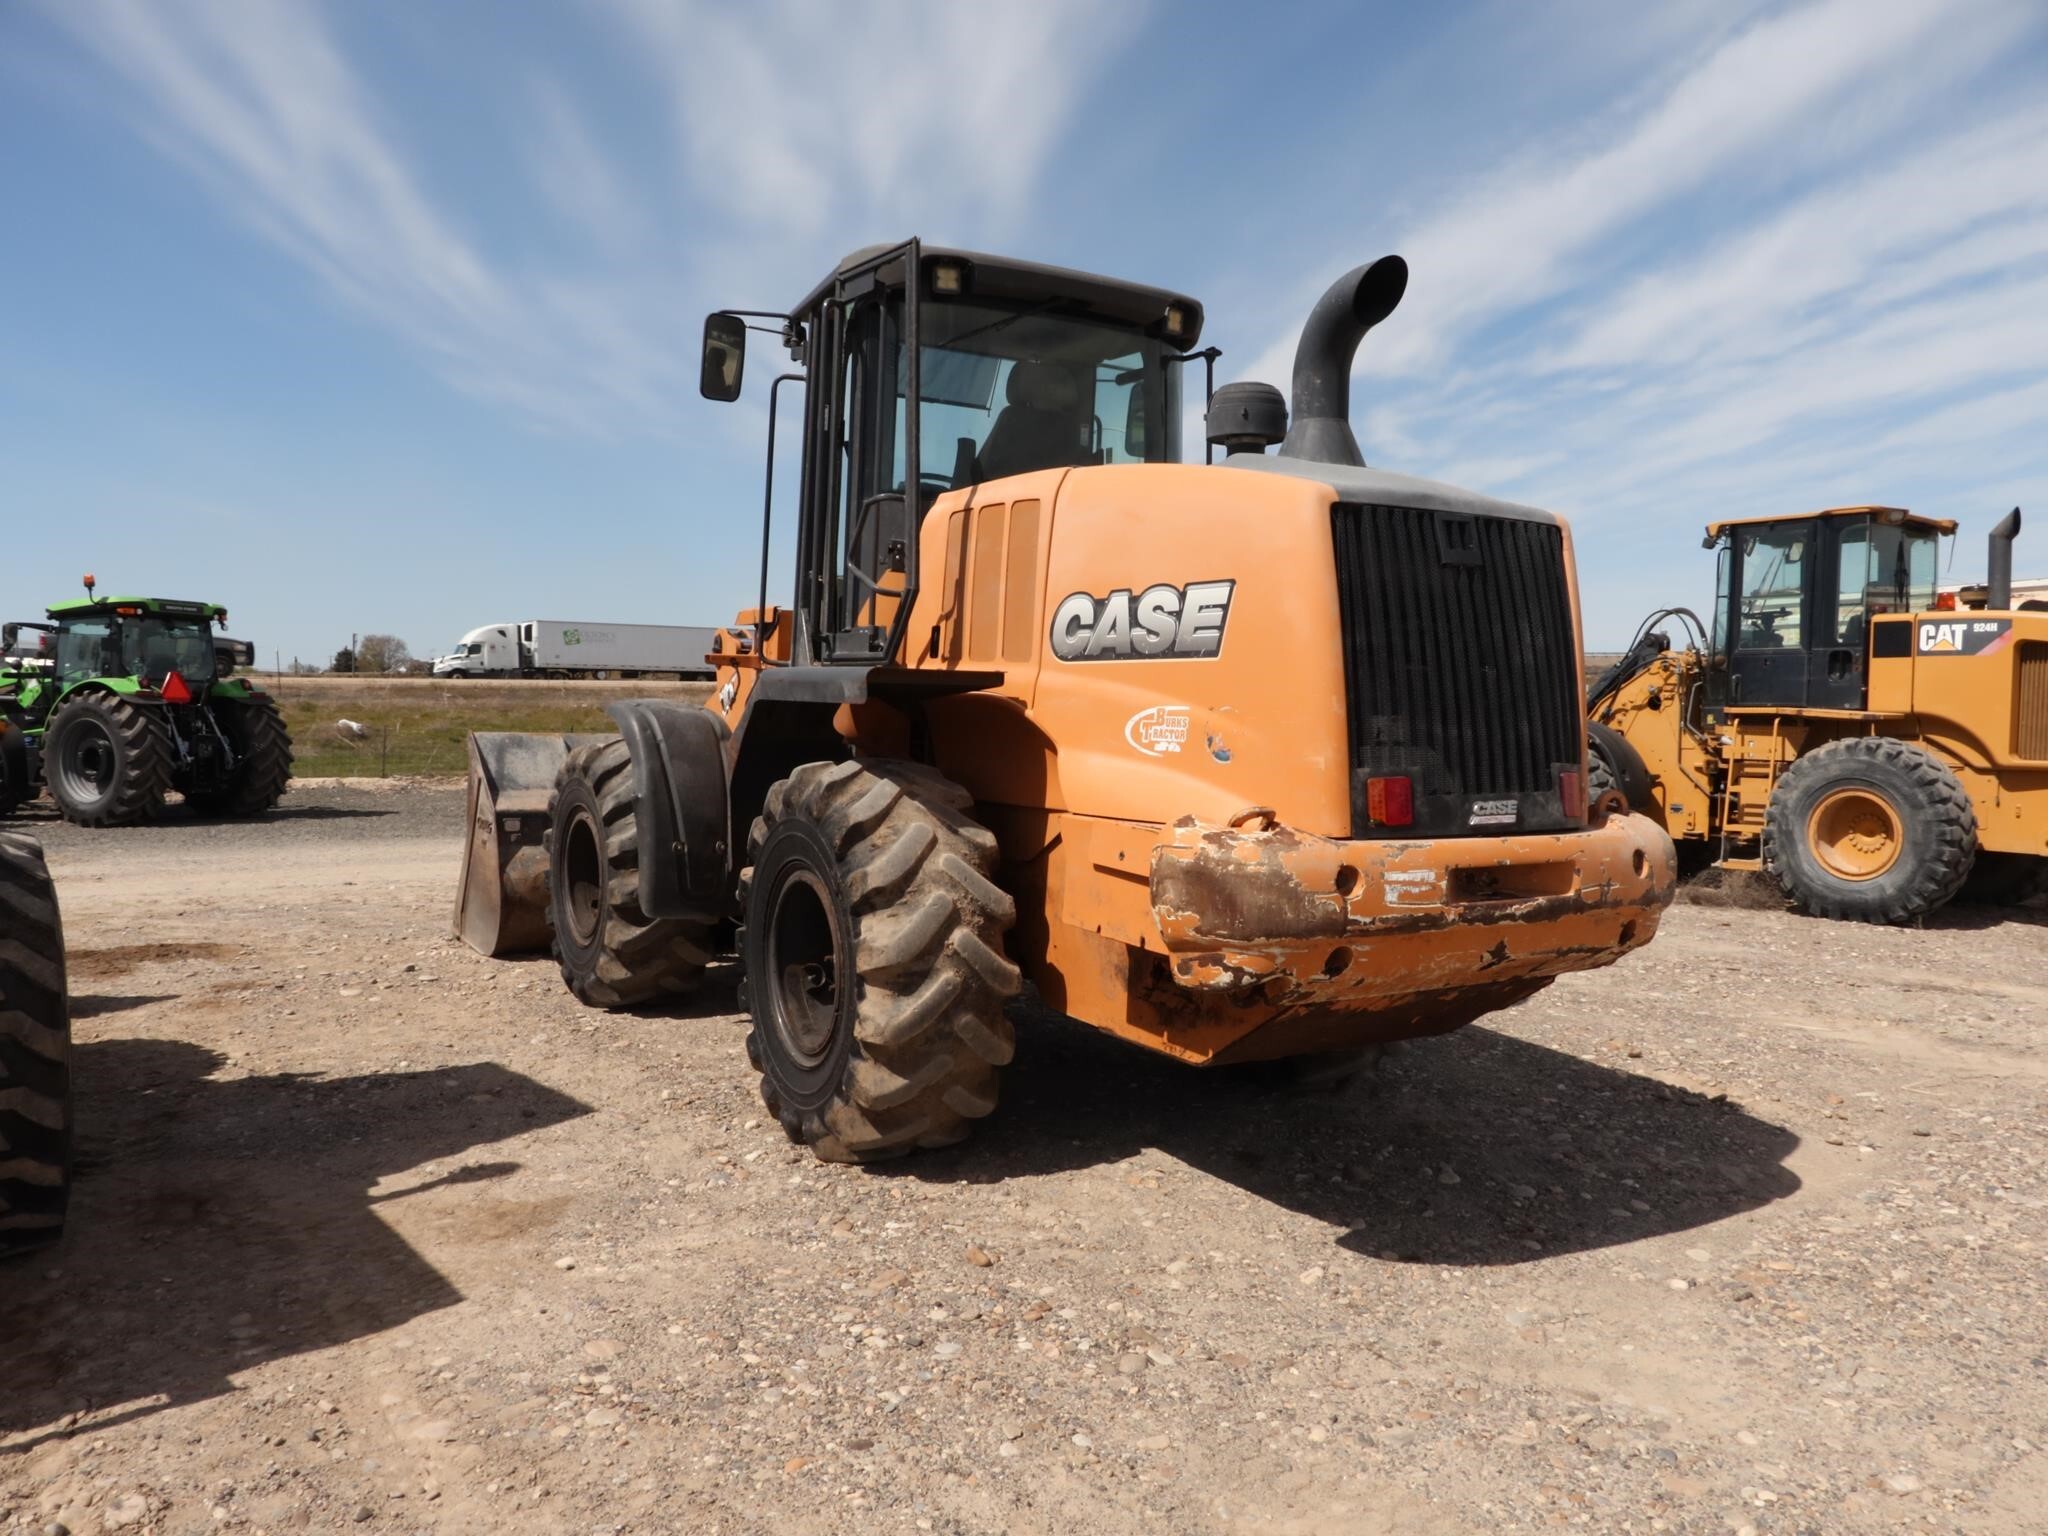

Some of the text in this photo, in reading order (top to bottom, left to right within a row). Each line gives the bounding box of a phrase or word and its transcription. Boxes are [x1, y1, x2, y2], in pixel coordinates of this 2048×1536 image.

[1051, 581, 1234, 660] CASE
[1919, 622, 1998, 651] CAT 924H
[1142, 721, 1186, 740] TRACTOR
[1472, 800, 1518, 815] CASE
